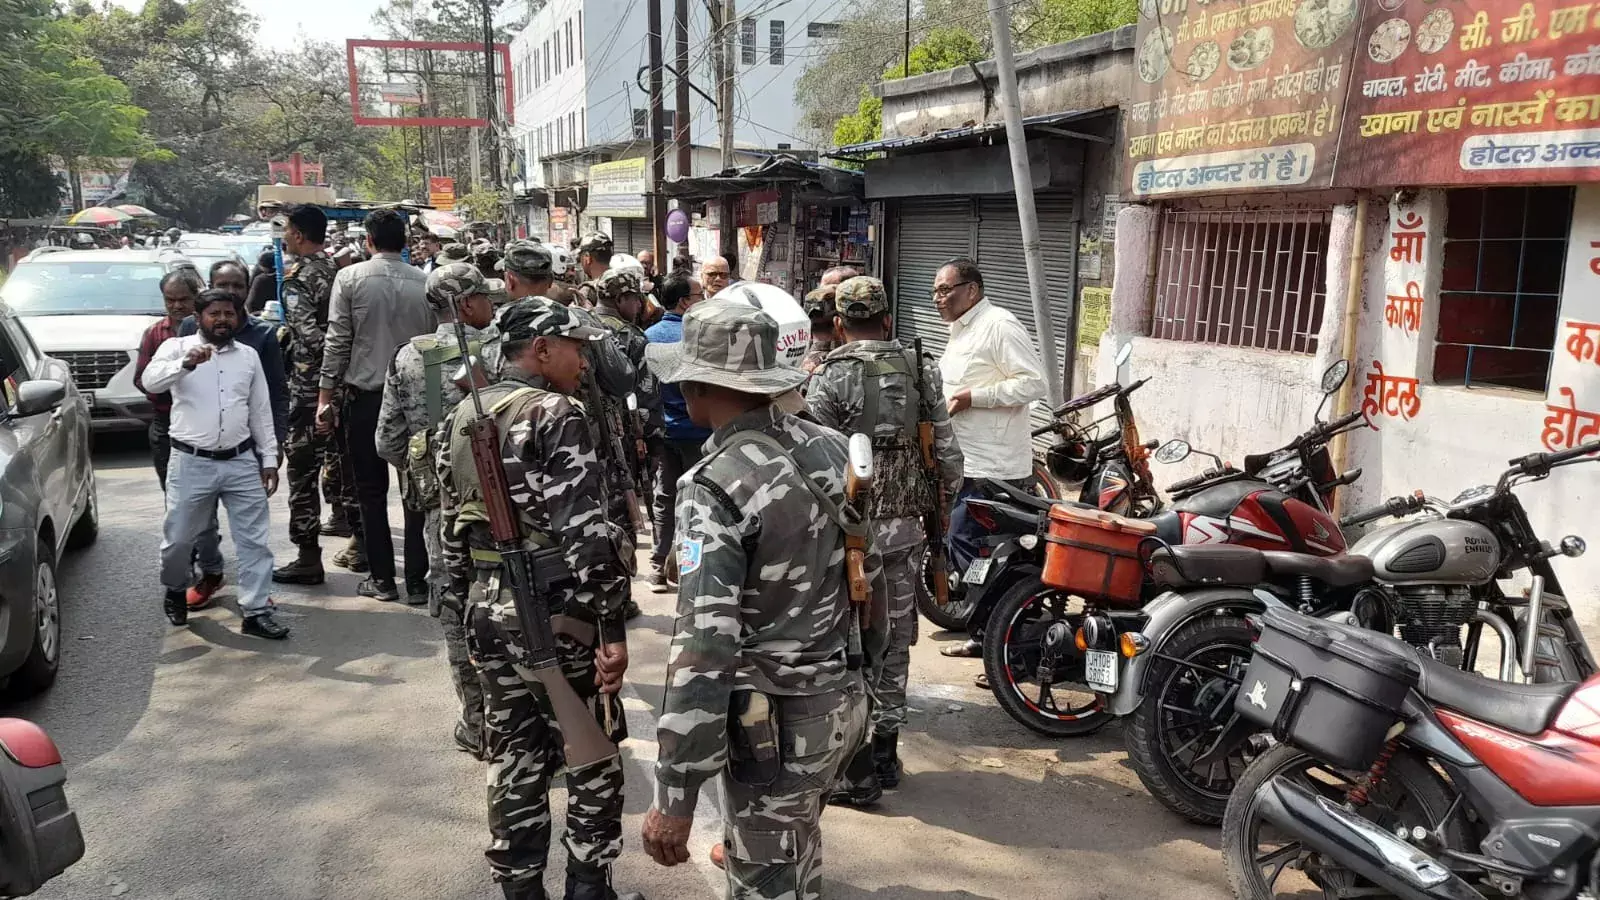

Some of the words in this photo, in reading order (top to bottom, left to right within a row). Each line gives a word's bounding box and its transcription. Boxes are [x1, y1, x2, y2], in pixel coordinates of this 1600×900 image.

[1461, 10, 1492, 51] सी.
[1501, 2, 1540, 43] जी.
[1548, 3, 1593, 39] एम
[1413, 63, 1448, 93] रोटी,
[1454, 59, 1492, 88] मीट,
[1499, 52, 1556, 83] कीमा,
[1360, 110, 1423, 137] खाना
[1426, 97, 1466, 132] एवं
[1129, 134, 1157, 158] खाना
[1157, 123, 1175, 155] एवं
[1469, 139, 1541, 167] होटल
[1137, 164, 1187, 191] होटल
[1186, 162, 1246, 186] अन्दर
[1249, 152, 1275, 180] में
[1385, 281, 1424, 338] काली
[1362, 360, 1422, 432] होटल
[1464, 536, 1489, 545] ROYAL
